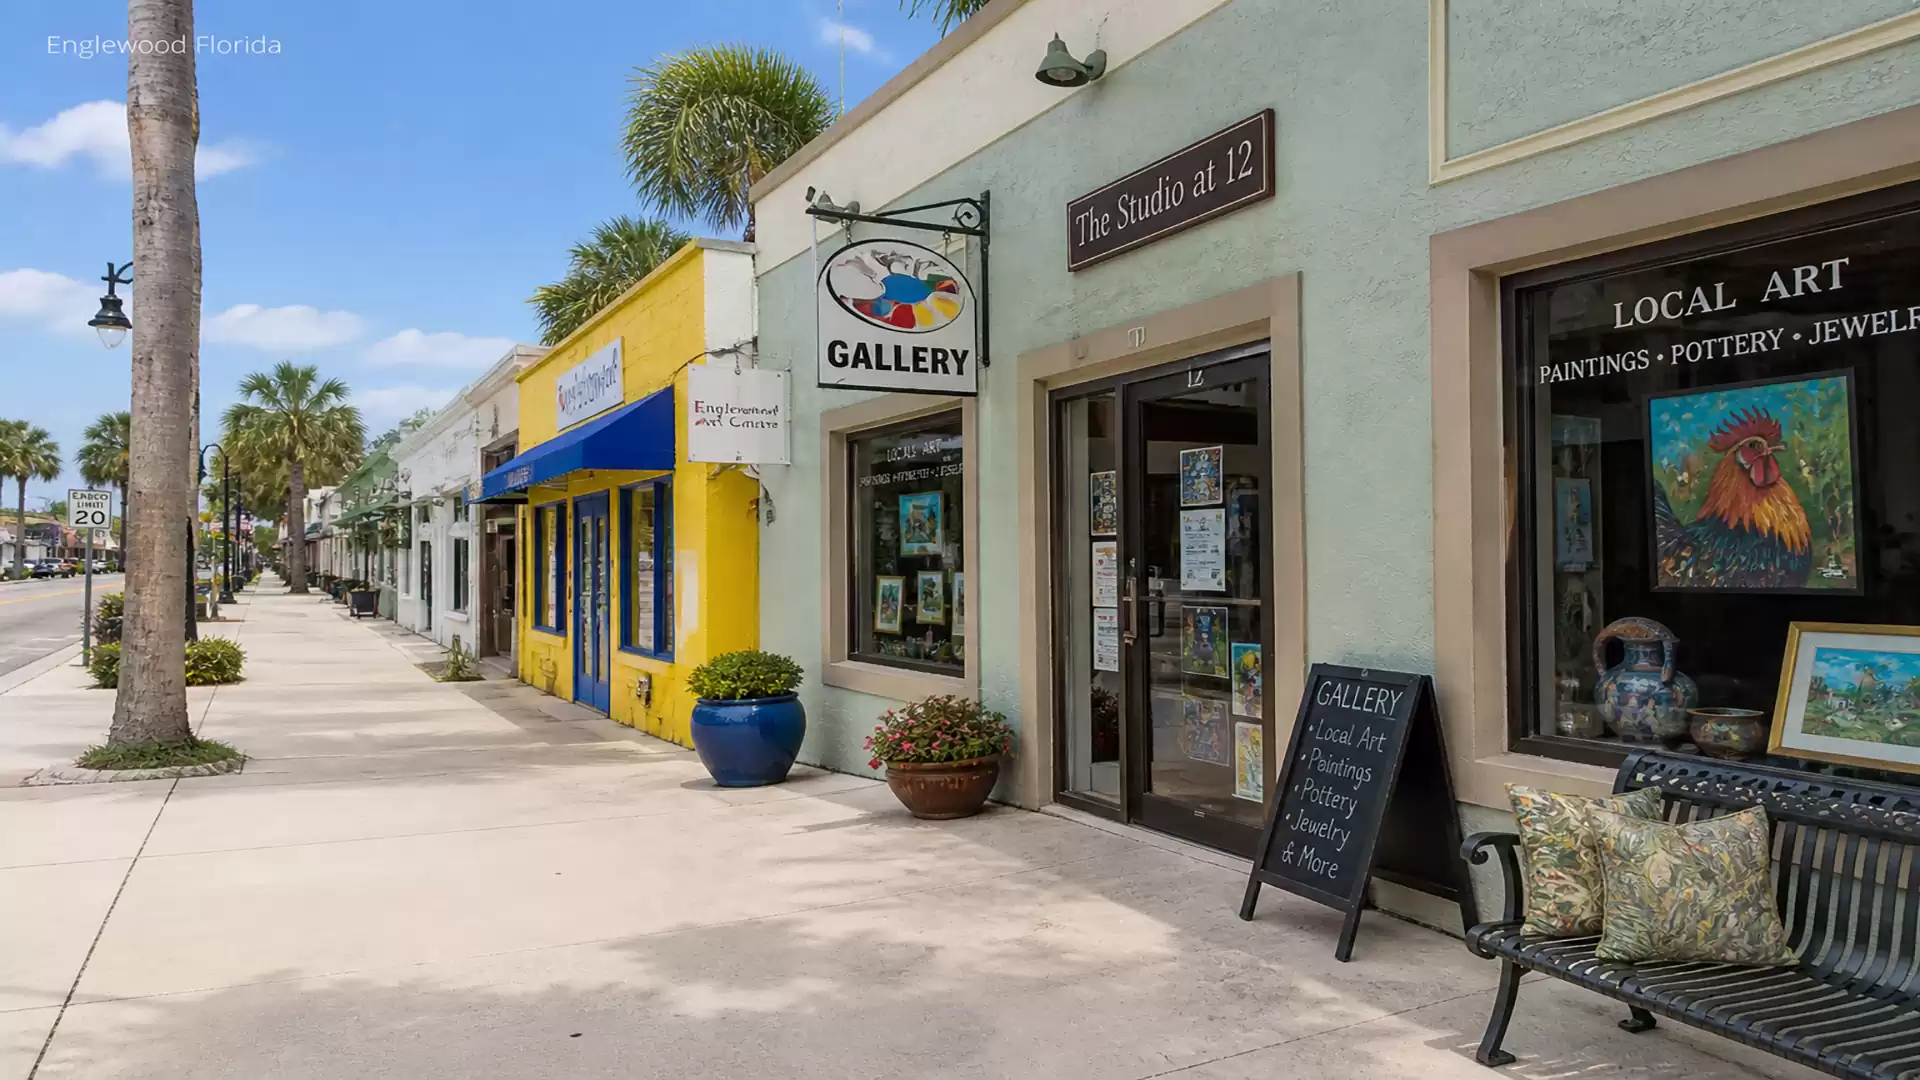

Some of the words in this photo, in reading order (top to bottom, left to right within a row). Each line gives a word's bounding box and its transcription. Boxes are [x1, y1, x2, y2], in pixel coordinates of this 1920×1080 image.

[1075, 206, 1111, 247] The
[1117, 175, 1185, 230] Studio
[1192, 159, 1217, 198] at
[1225, 139, 1254, 185] 12
[1613, 281, 1737, 330] LOCAL
[1760, 257, 1849, 302] ART
[827, 339, 970, 376] GALLERY
[1538, 348, 1651, 385] PAINTINGS
[1670, 327, 1784, 366] POTTERY
[74, 509, 106, 525] 20
[1316, 680, 1404, 717] GALLERY
[1315, 719, 1355, 746] Local
[1356, 726, 1388, 753] Art
[1307, 747, 1373, 791] Paintings
[1300, 777, 1358, 820] Pottery
[1290, 808, 1351, 852] Jewelry
[1281, 841, 1295, 865] &
[1297, 844, 1340, 880] More
